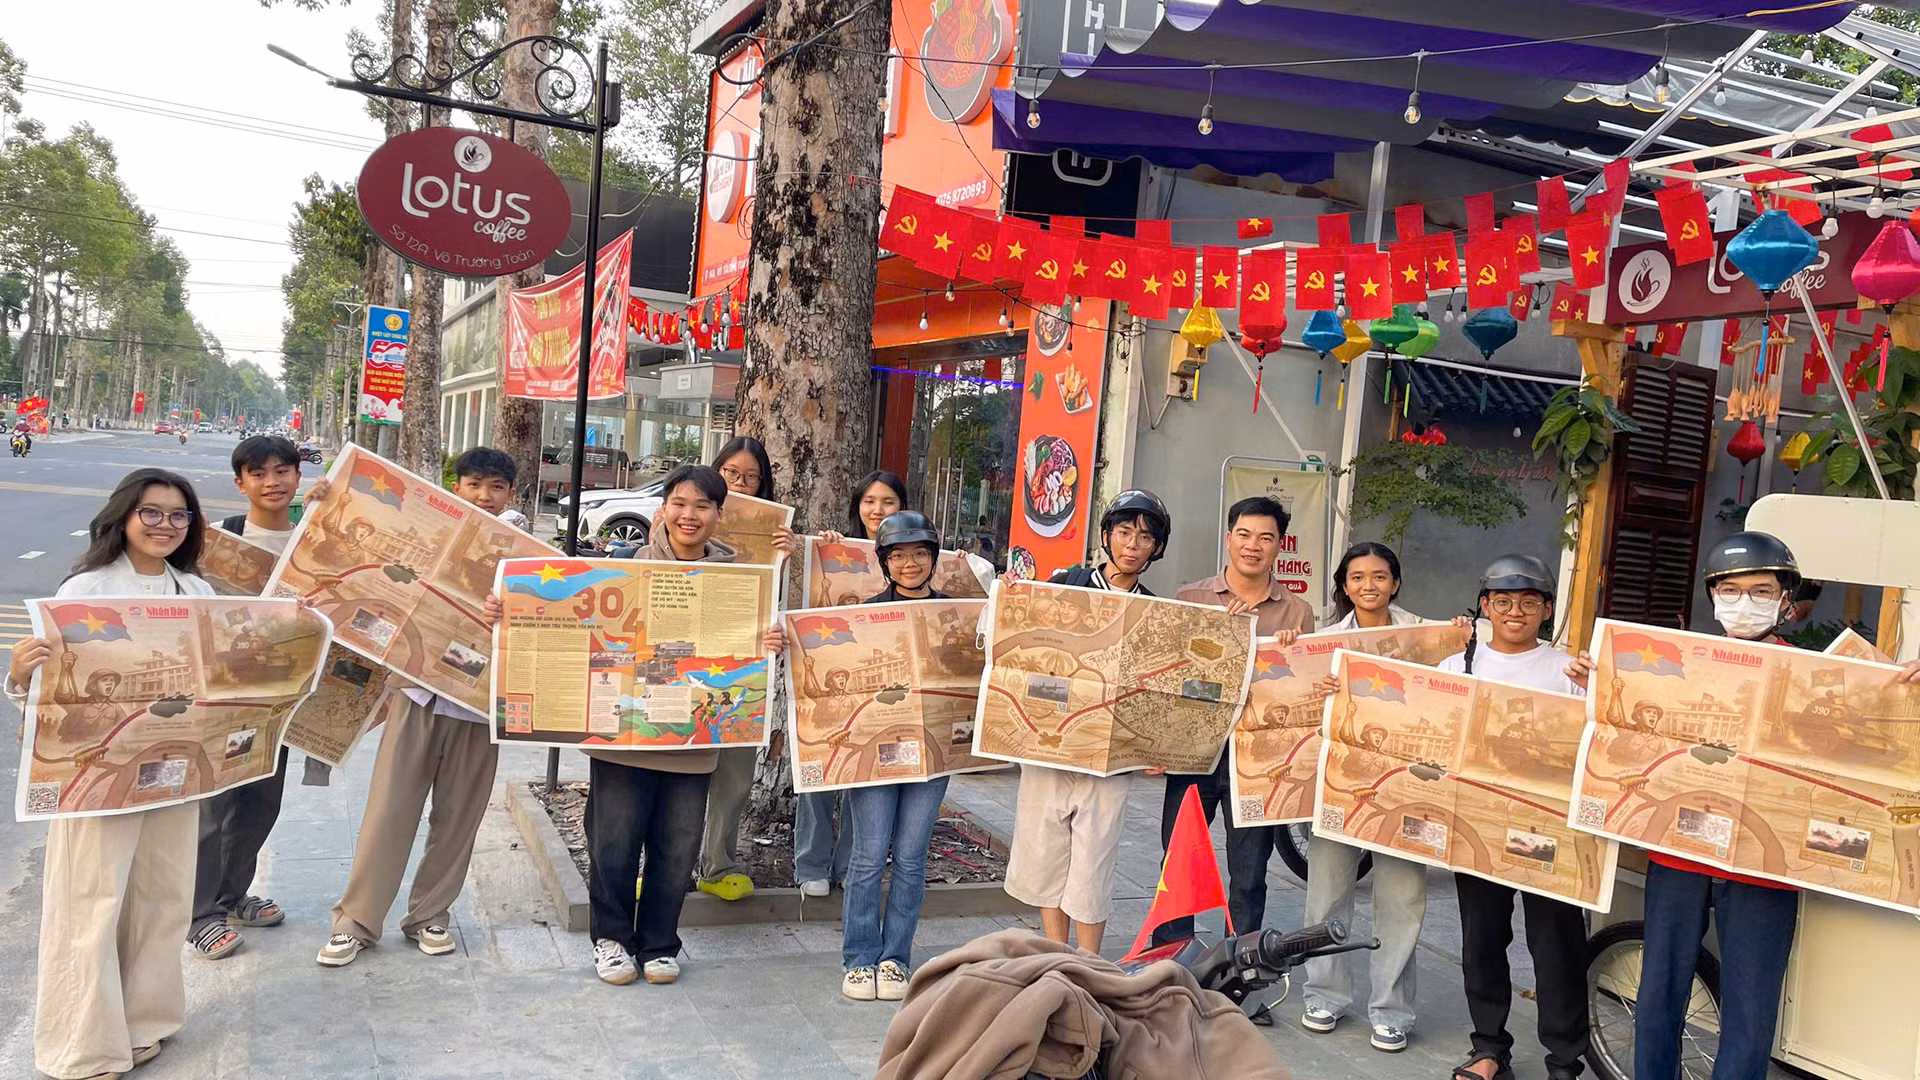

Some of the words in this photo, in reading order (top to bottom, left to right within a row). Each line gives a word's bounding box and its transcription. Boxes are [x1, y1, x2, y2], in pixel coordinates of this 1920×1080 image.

[473, 220, 527, 244] coffee
[869, 611, 890, 622] Nhân
[1306, 642, 1329, 654] Nhân
[1712, 648, 1740, 662] Nhân
[1740, 654, 1763, 666] Dân
[1428, 678, 1451, 690] Nhân
[1452, 684, 1469, 696] Dân
[1812, 706, 1830, 716] 390
[1507, 729, 1522, 739] 390
